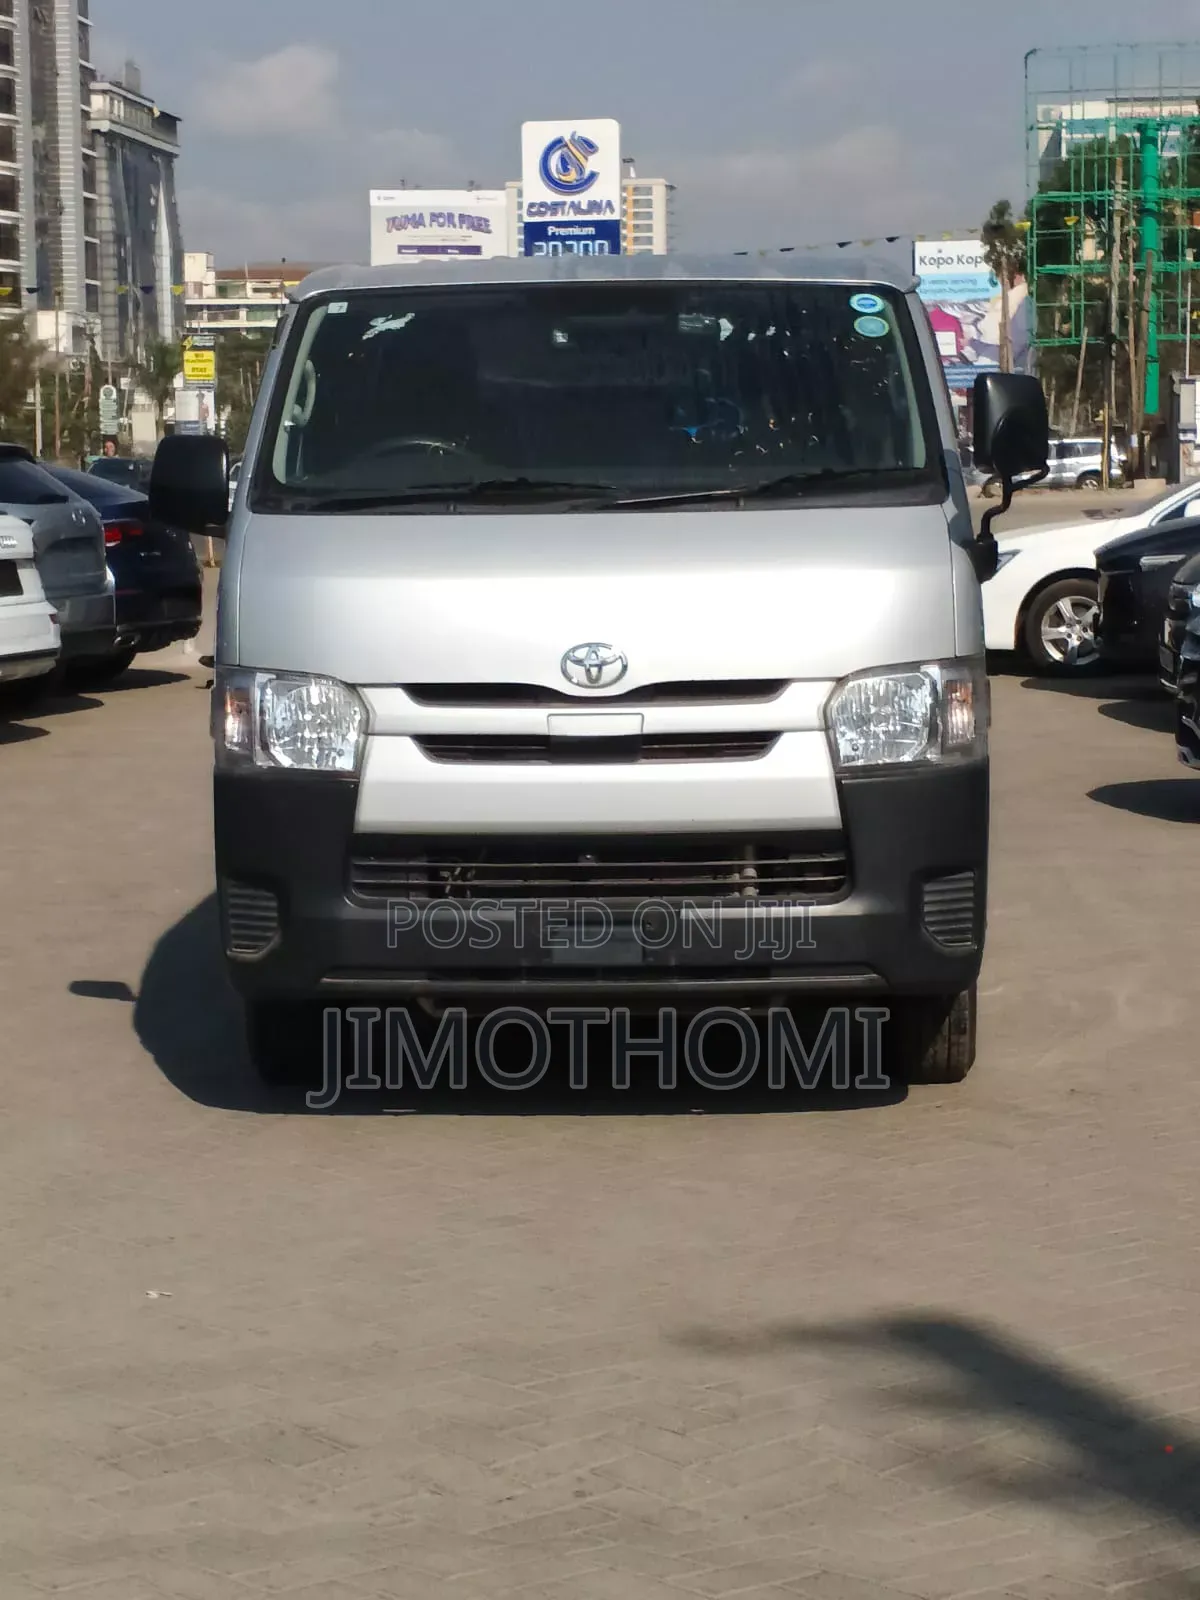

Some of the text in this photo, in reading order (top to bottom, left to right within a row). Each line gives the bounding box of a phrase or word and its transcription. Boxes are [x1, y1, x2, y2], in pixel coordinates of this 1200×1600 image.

[429, 211, 457, 229] FOR
[458, 213, 492, 234] FREE
[547, 225, 596, 236] Premium
[919, 254, 984, 268] Kopo Kop
